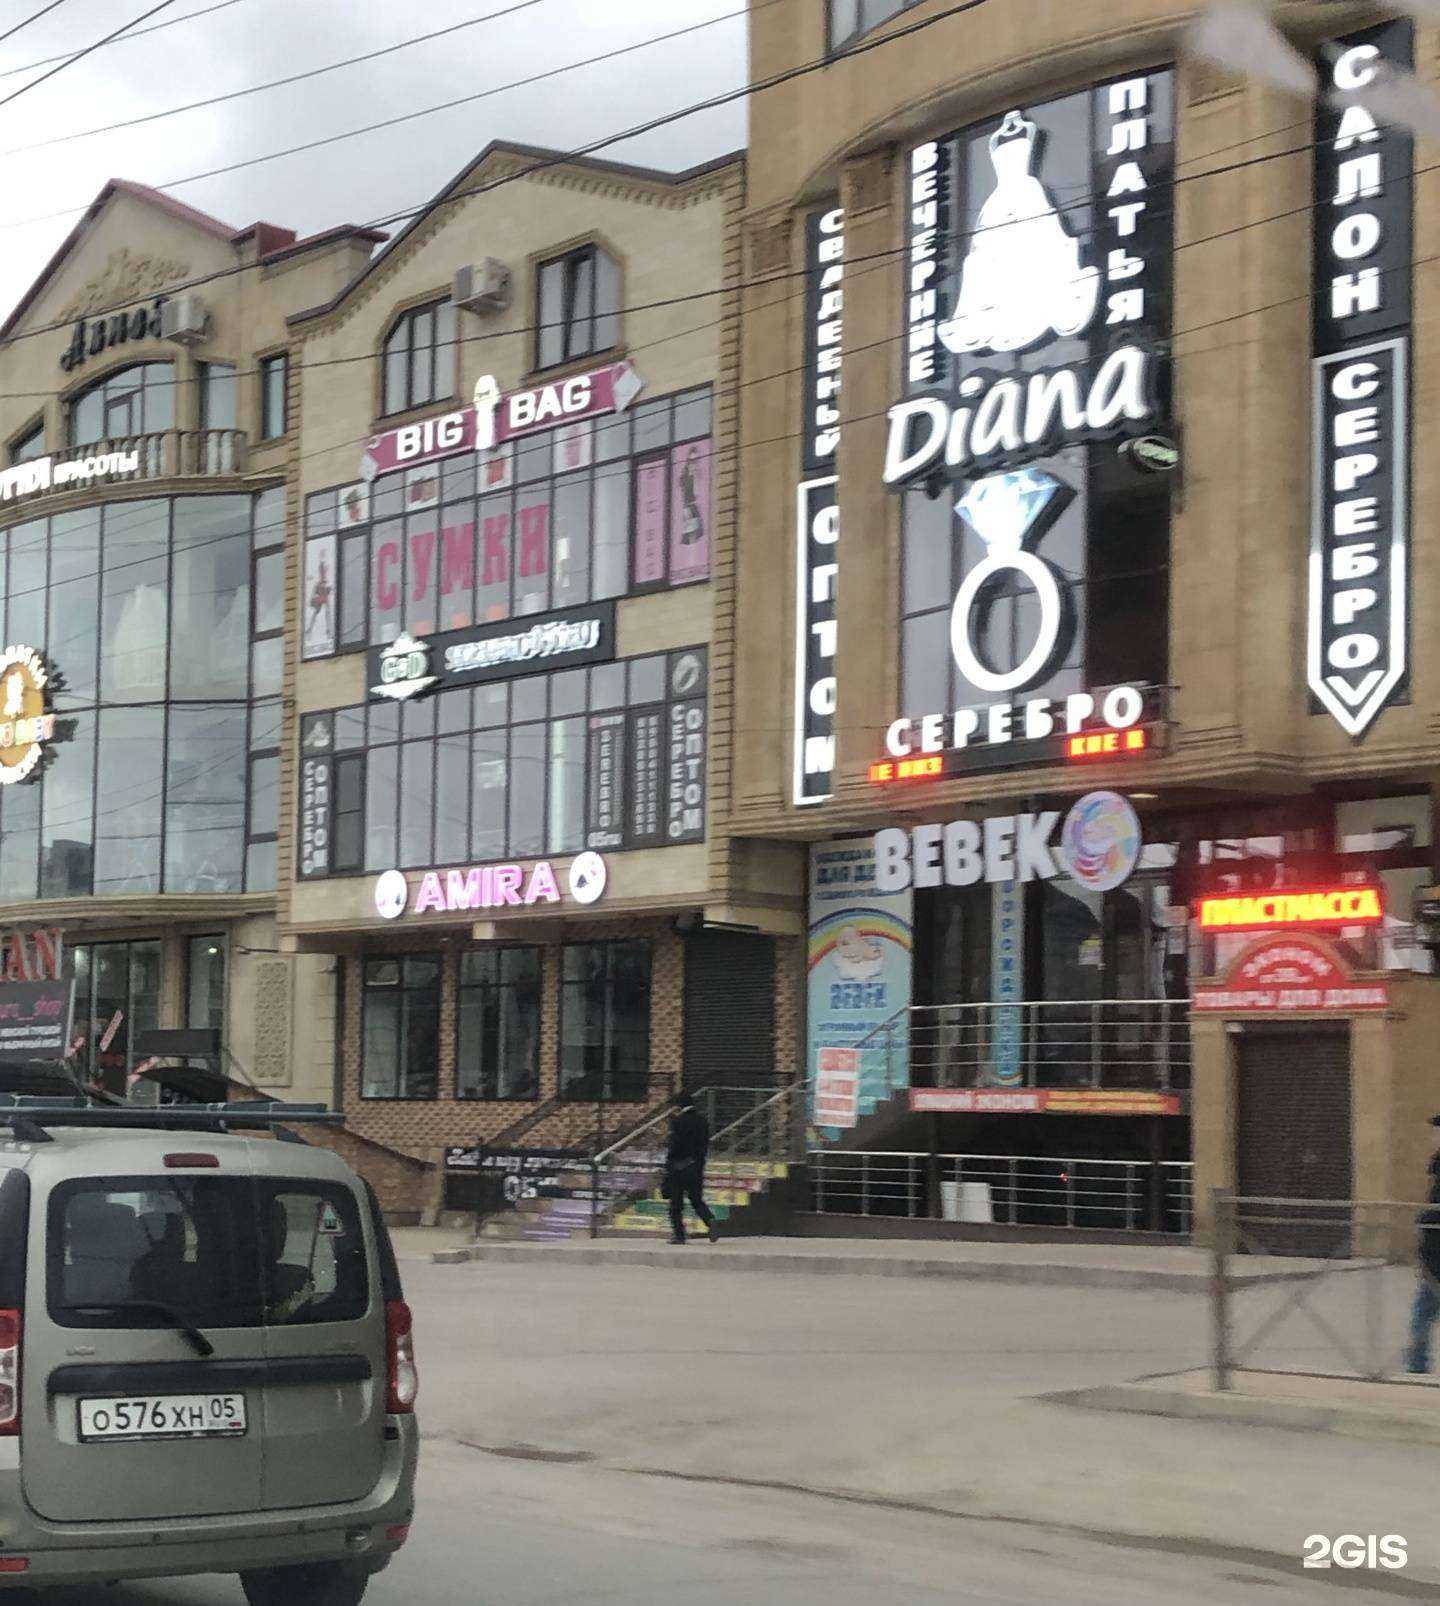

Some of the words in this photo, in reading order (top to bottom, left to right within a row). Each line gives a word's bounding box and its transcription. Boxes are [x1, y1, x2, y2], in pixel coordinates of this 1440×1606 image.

[1106, 77, 1147, 325] ПЛАТЬЯ
[1332, 44, 1381, 318] САЛОН
[910, 141, 939, 384] ВЕЧЕРНИЕ
[396, 413, 464, 461] BIG
[509, 374, 592, 429] BAG
[882, 345, 1150, 484] Diana
[1327, 363, 1380, 669] СЕРЕБРО
[886, 686, 1143, 757] СЕРЕБРО
[414, 861, 561, 913] AMIRA
[874, 811, 1063, 893] BEBEK
[209, 1397, 236, 1418] 05
